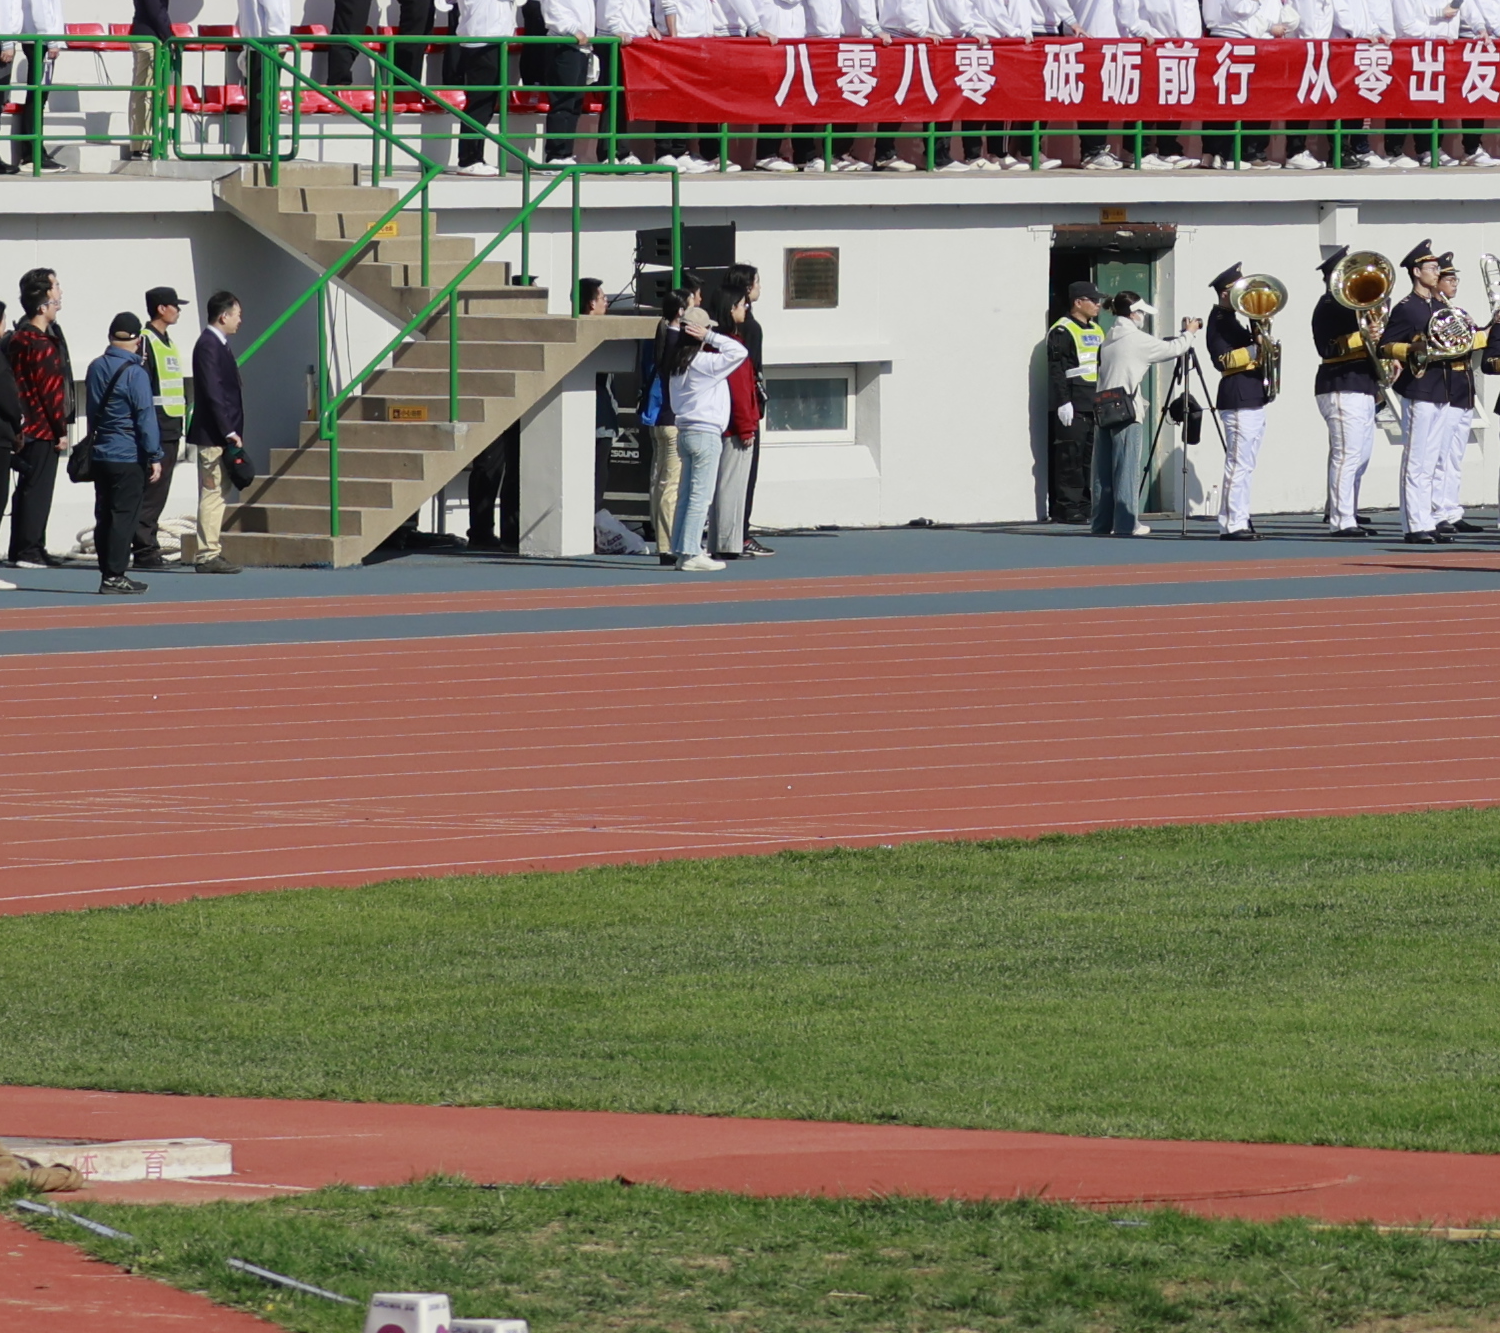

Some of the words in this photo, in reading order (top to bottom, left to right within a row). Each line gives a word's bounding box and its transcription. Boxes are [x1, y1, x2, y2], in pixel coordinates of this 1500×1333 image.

[775, 43, 996, 107] 八零八零
[1042, 41, 1256, 105] 砥砺前行
[1296, 41, 1500, 104] 从零出发
